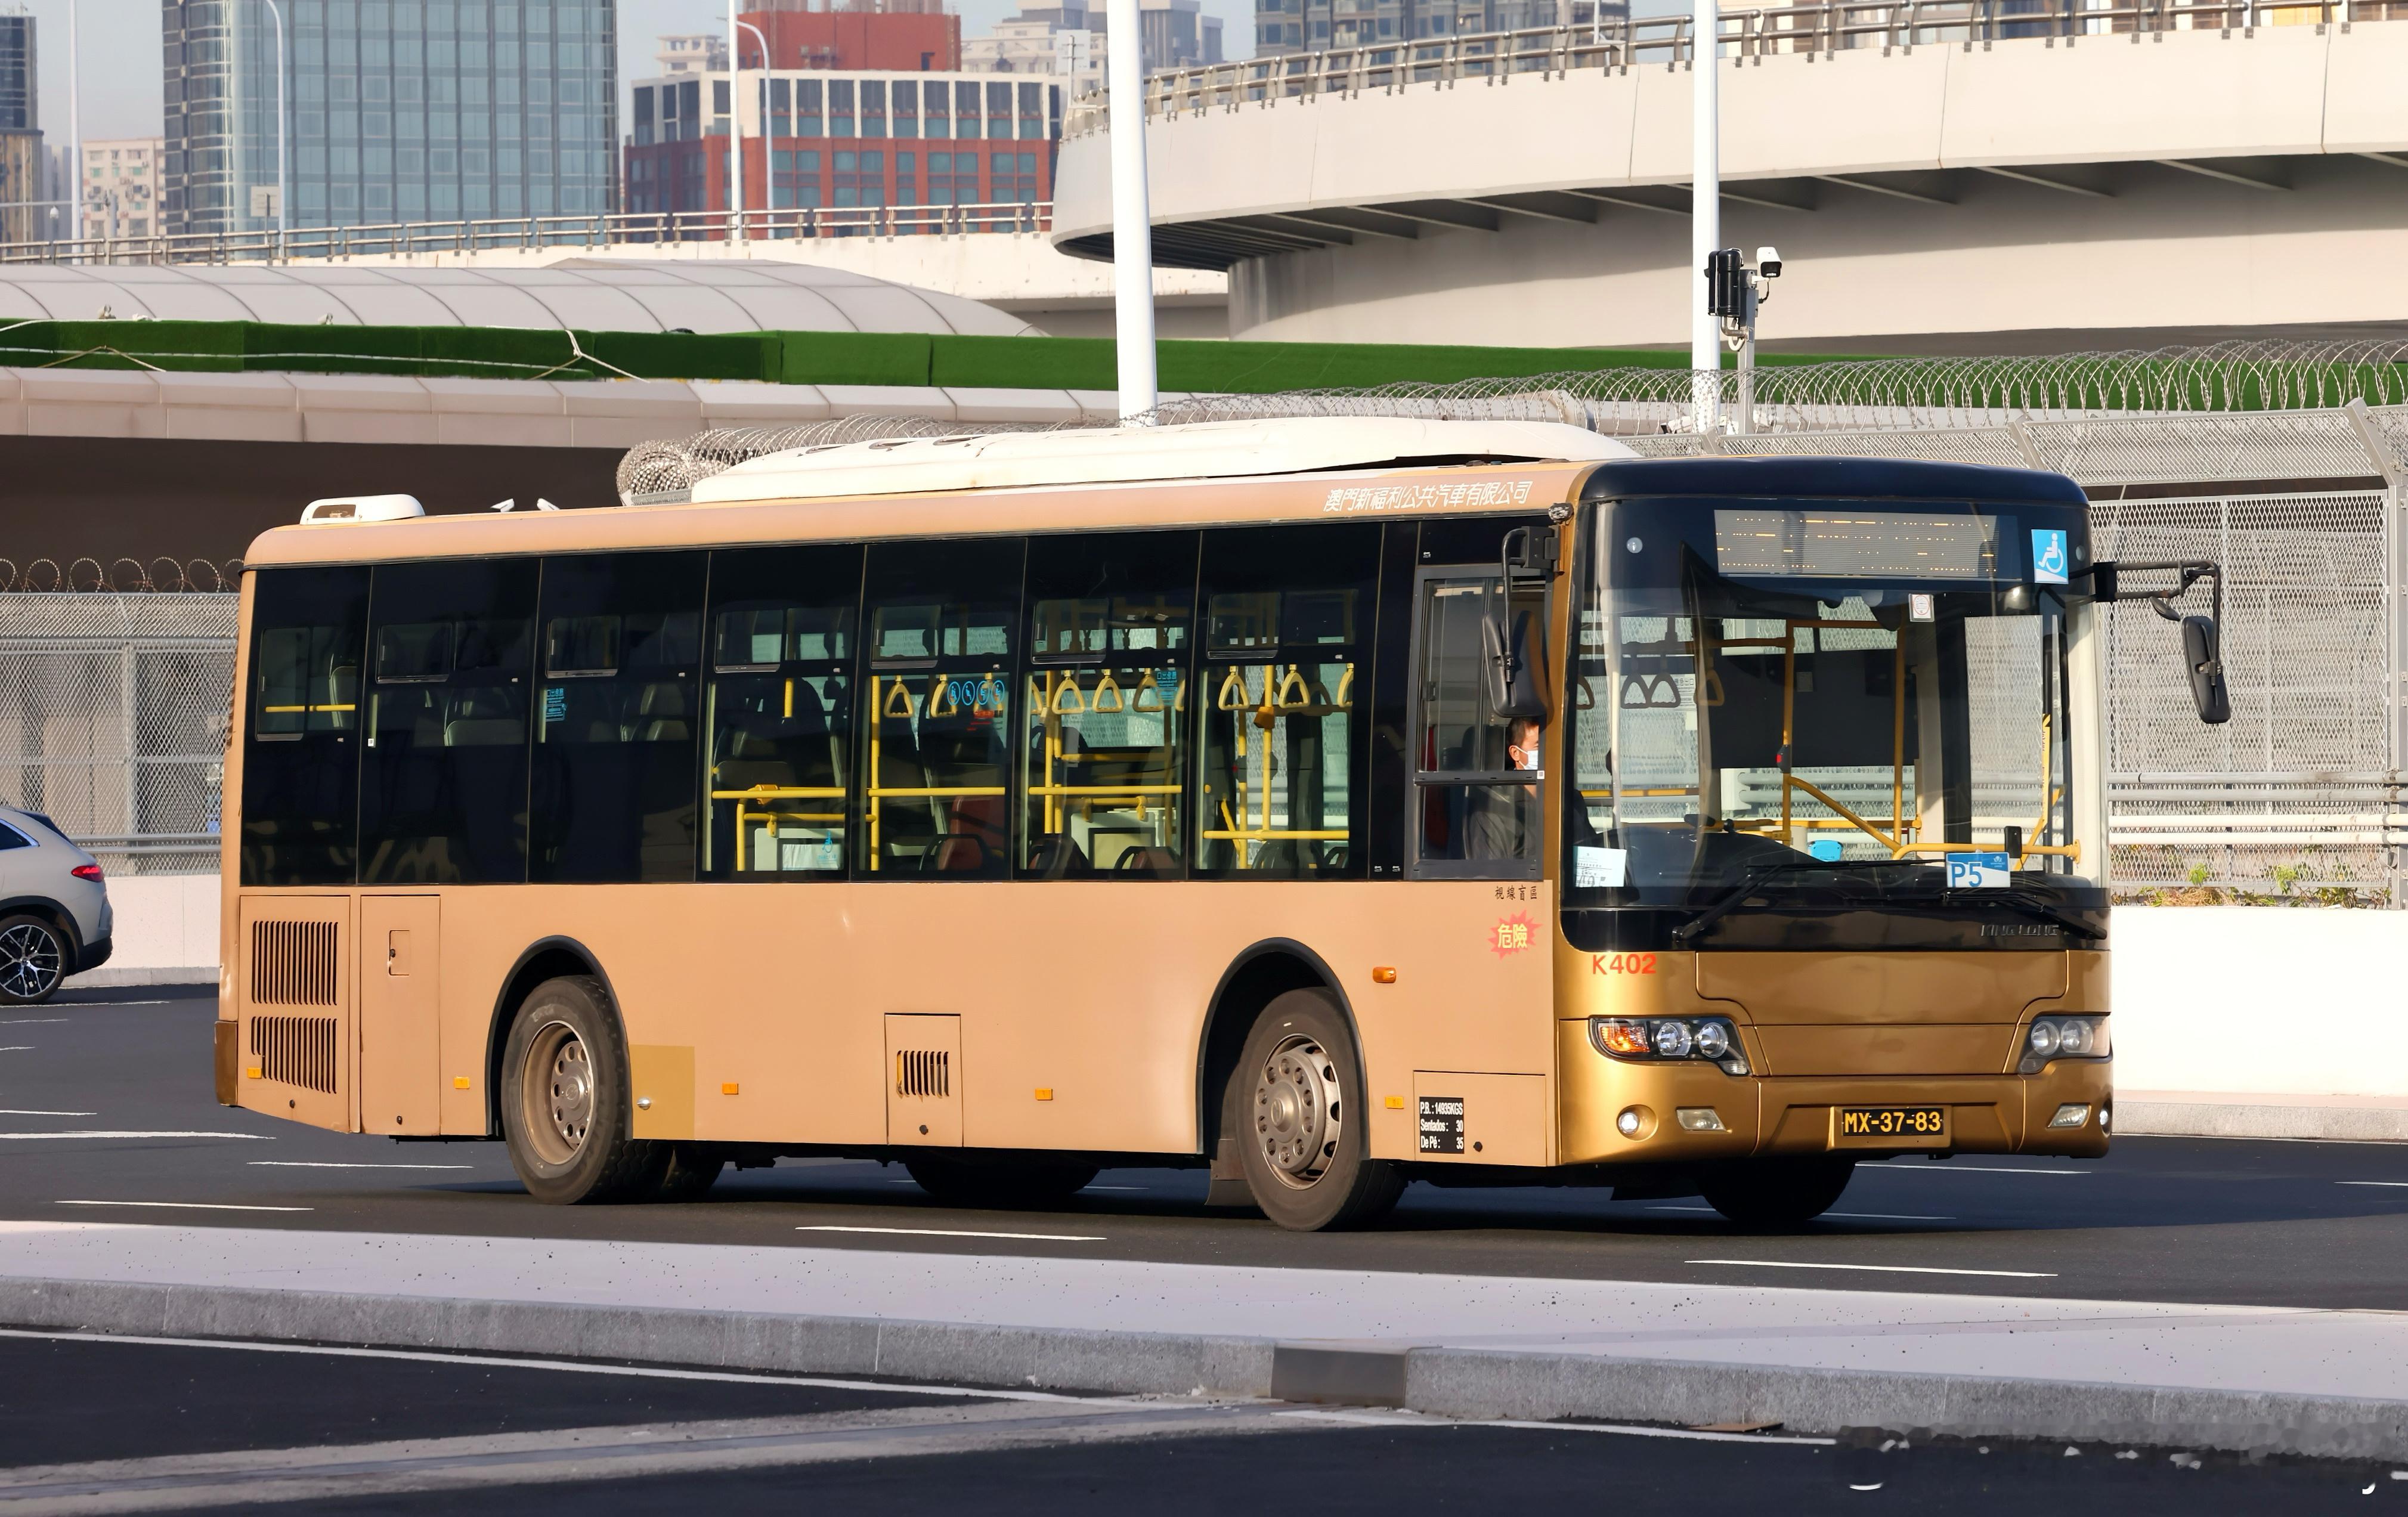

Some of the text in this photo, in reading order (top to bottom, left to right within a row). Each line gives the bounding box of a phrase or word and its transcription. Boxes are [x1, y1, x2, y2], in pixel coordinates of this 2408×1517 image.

[1323, 481, 1533, 512] 澳門新福利公共汽車有限公司
[1951, 862, 1982, 887] P5
[1497, 924, 1527, 949] 危險
[1593, 954, 1657, 975] K402
[1456, 1119, 1464, 1132] 30
[1844, 1112, 1941, 1132] MX-37-83
[1420, 1135, 1429, 1148] De
[1456, 1137, 1464, 1150] 35
